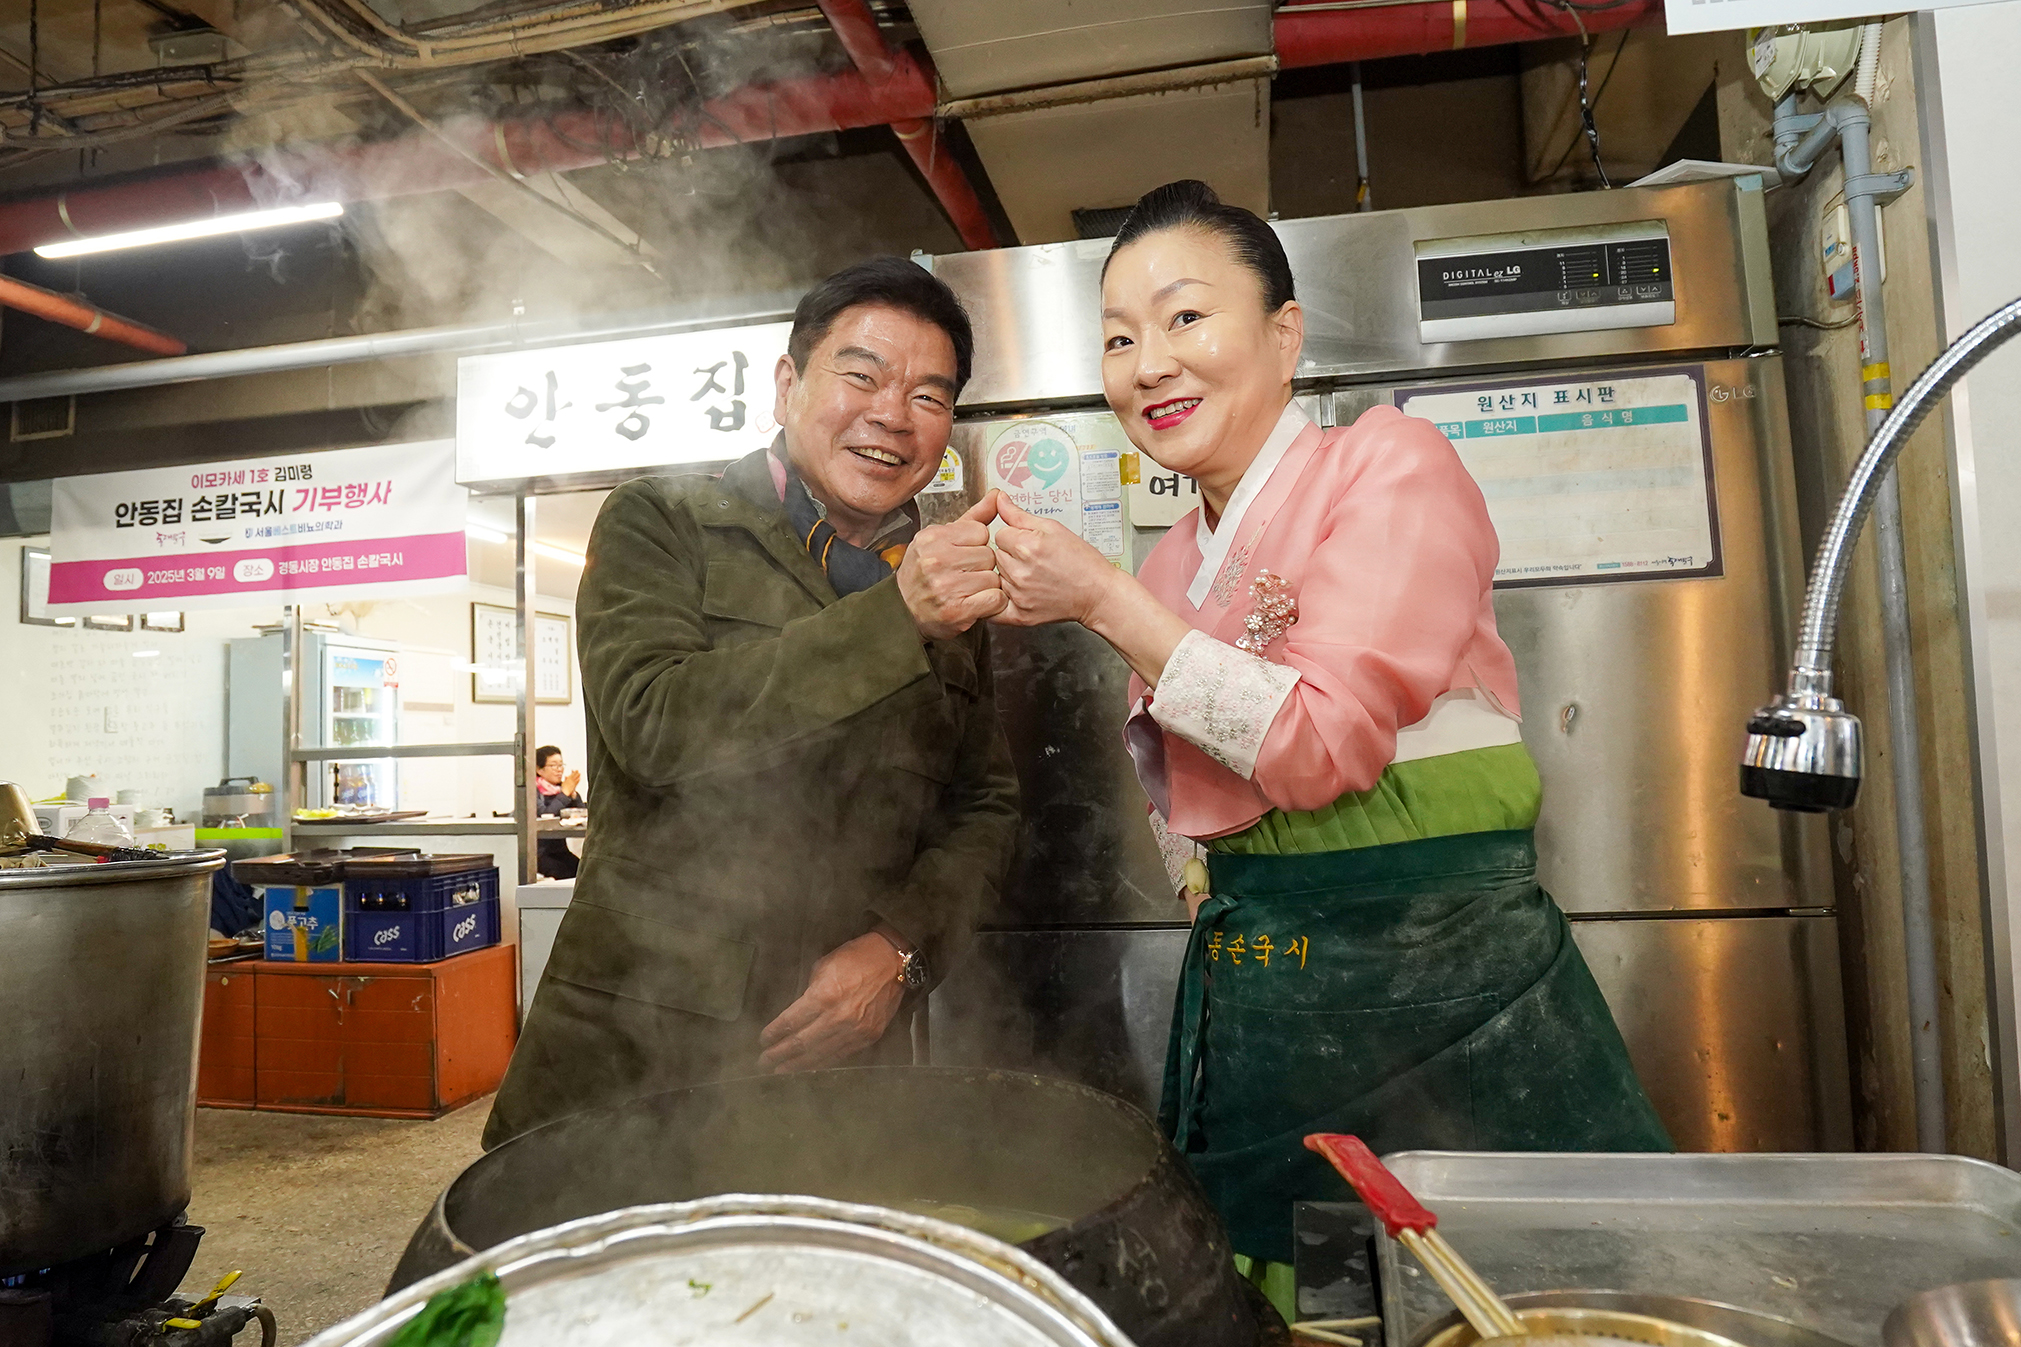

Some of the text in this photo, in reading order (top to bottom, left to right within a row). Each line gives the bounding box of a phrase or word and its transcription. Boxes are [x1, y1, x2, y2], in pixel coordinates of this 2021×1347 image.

[1443, 268, 1492, 280] DIGITAL
[1506, 265, 1521, 275] LG
[505, 350, 749, 449] 안동집
[1477, 386, 1615, 412] 원산지 표시판
[1437, 424, 1462, 437] 품목
[1482, 420, 1518, 434] 원산지
[191, 464, 313, 489] 이모카세 1호 김미령
[115, 480, 392, 528] 안동집 손칼국시 기부행사
[1049, 489, 1072, 503] 당신
[254, 519, 343, 538] 서울베스트비뇨의학과
[113, 552, 404, 586] 일시 2025년 3월 9일 장소 경동시장 안동집 손칼국시
